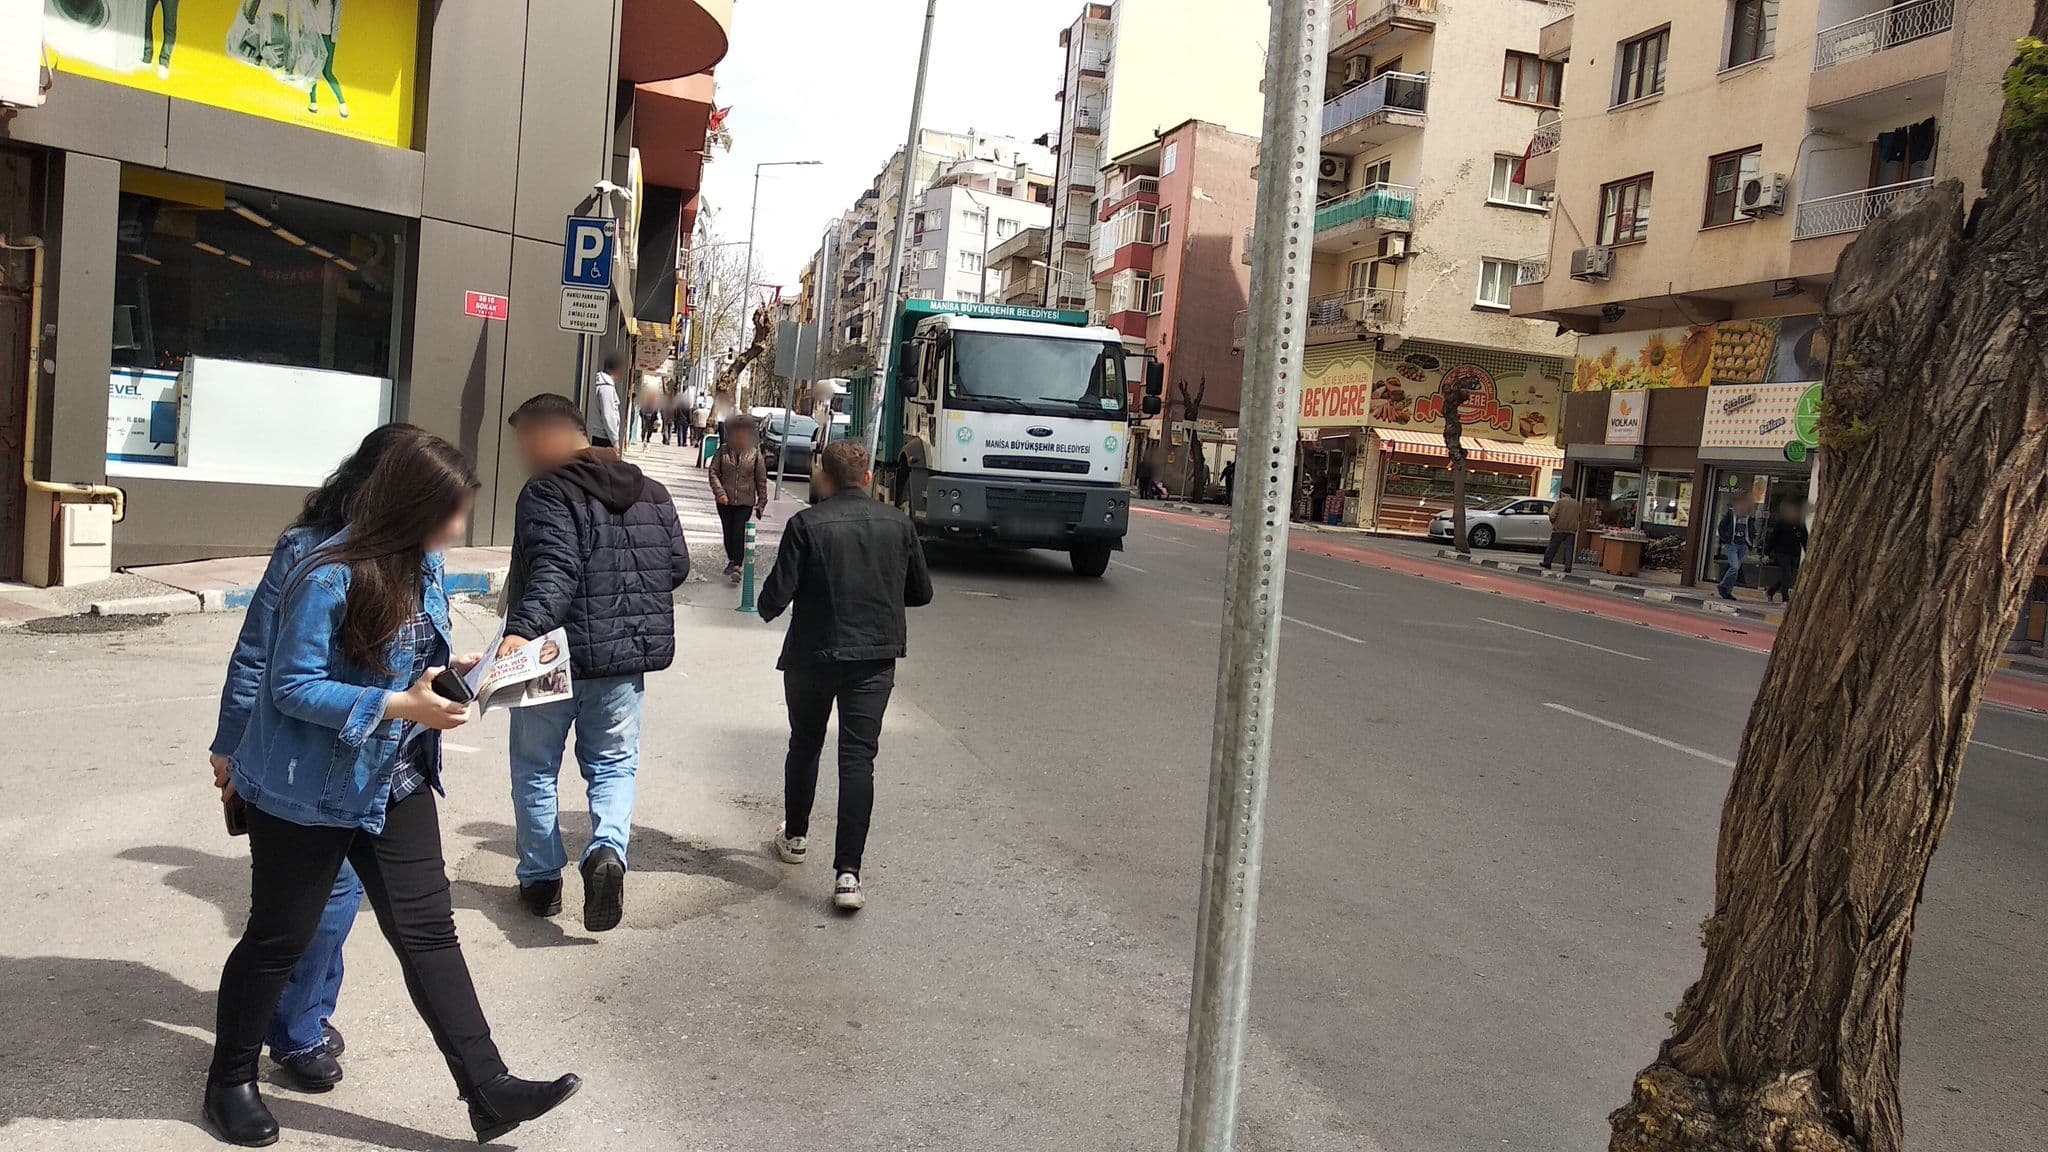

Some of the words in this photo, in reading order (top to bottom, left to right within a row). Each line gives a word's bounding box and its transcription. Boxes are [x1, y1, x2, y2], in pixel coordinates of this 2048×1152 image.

[573, 225, 605, 277] P
[475, 302, 497, 312] SOKAK
[930, 301, 959, 311] MANİSA
[960, 302, 1015, 316] BÜYÜKŞEHİR
[1017, 308, 1060, 319] BELEDİYESİ
[1303, 384, 1367, 417] BEYDERE
[1611, 418, 1639, 427] VOLKAN
[985, 439, 1009, 449] MANİSA
[1010, 440, 1055, 453] BÜYÜKŞEHİR
[1055, 443, 1091, 454] BELEDİYESİ
